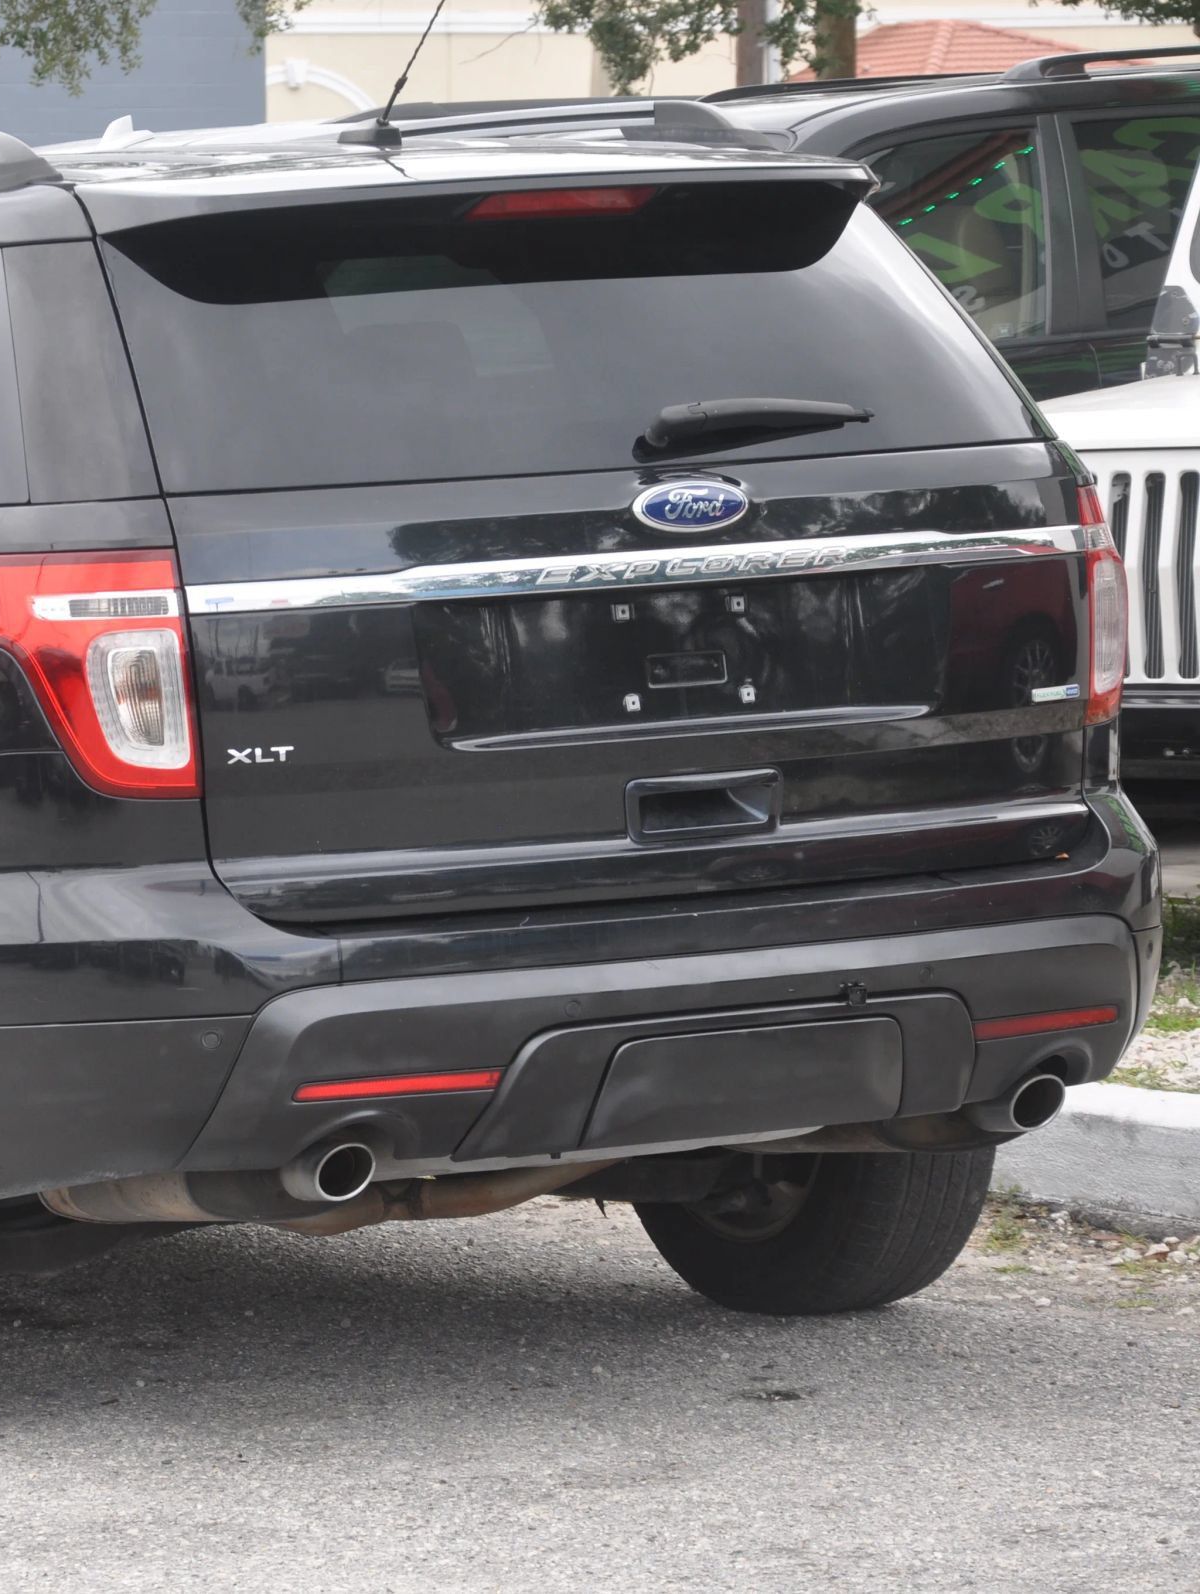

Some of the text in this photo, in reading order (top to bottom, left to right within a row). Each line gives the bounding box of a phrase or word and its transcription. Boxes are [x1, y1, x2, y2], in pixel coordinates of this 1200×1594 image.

[664, 488, 725, 520] Ford
[535, 545, 849, 586] EXPLORER
[226, 745, 295, 765] XLT
